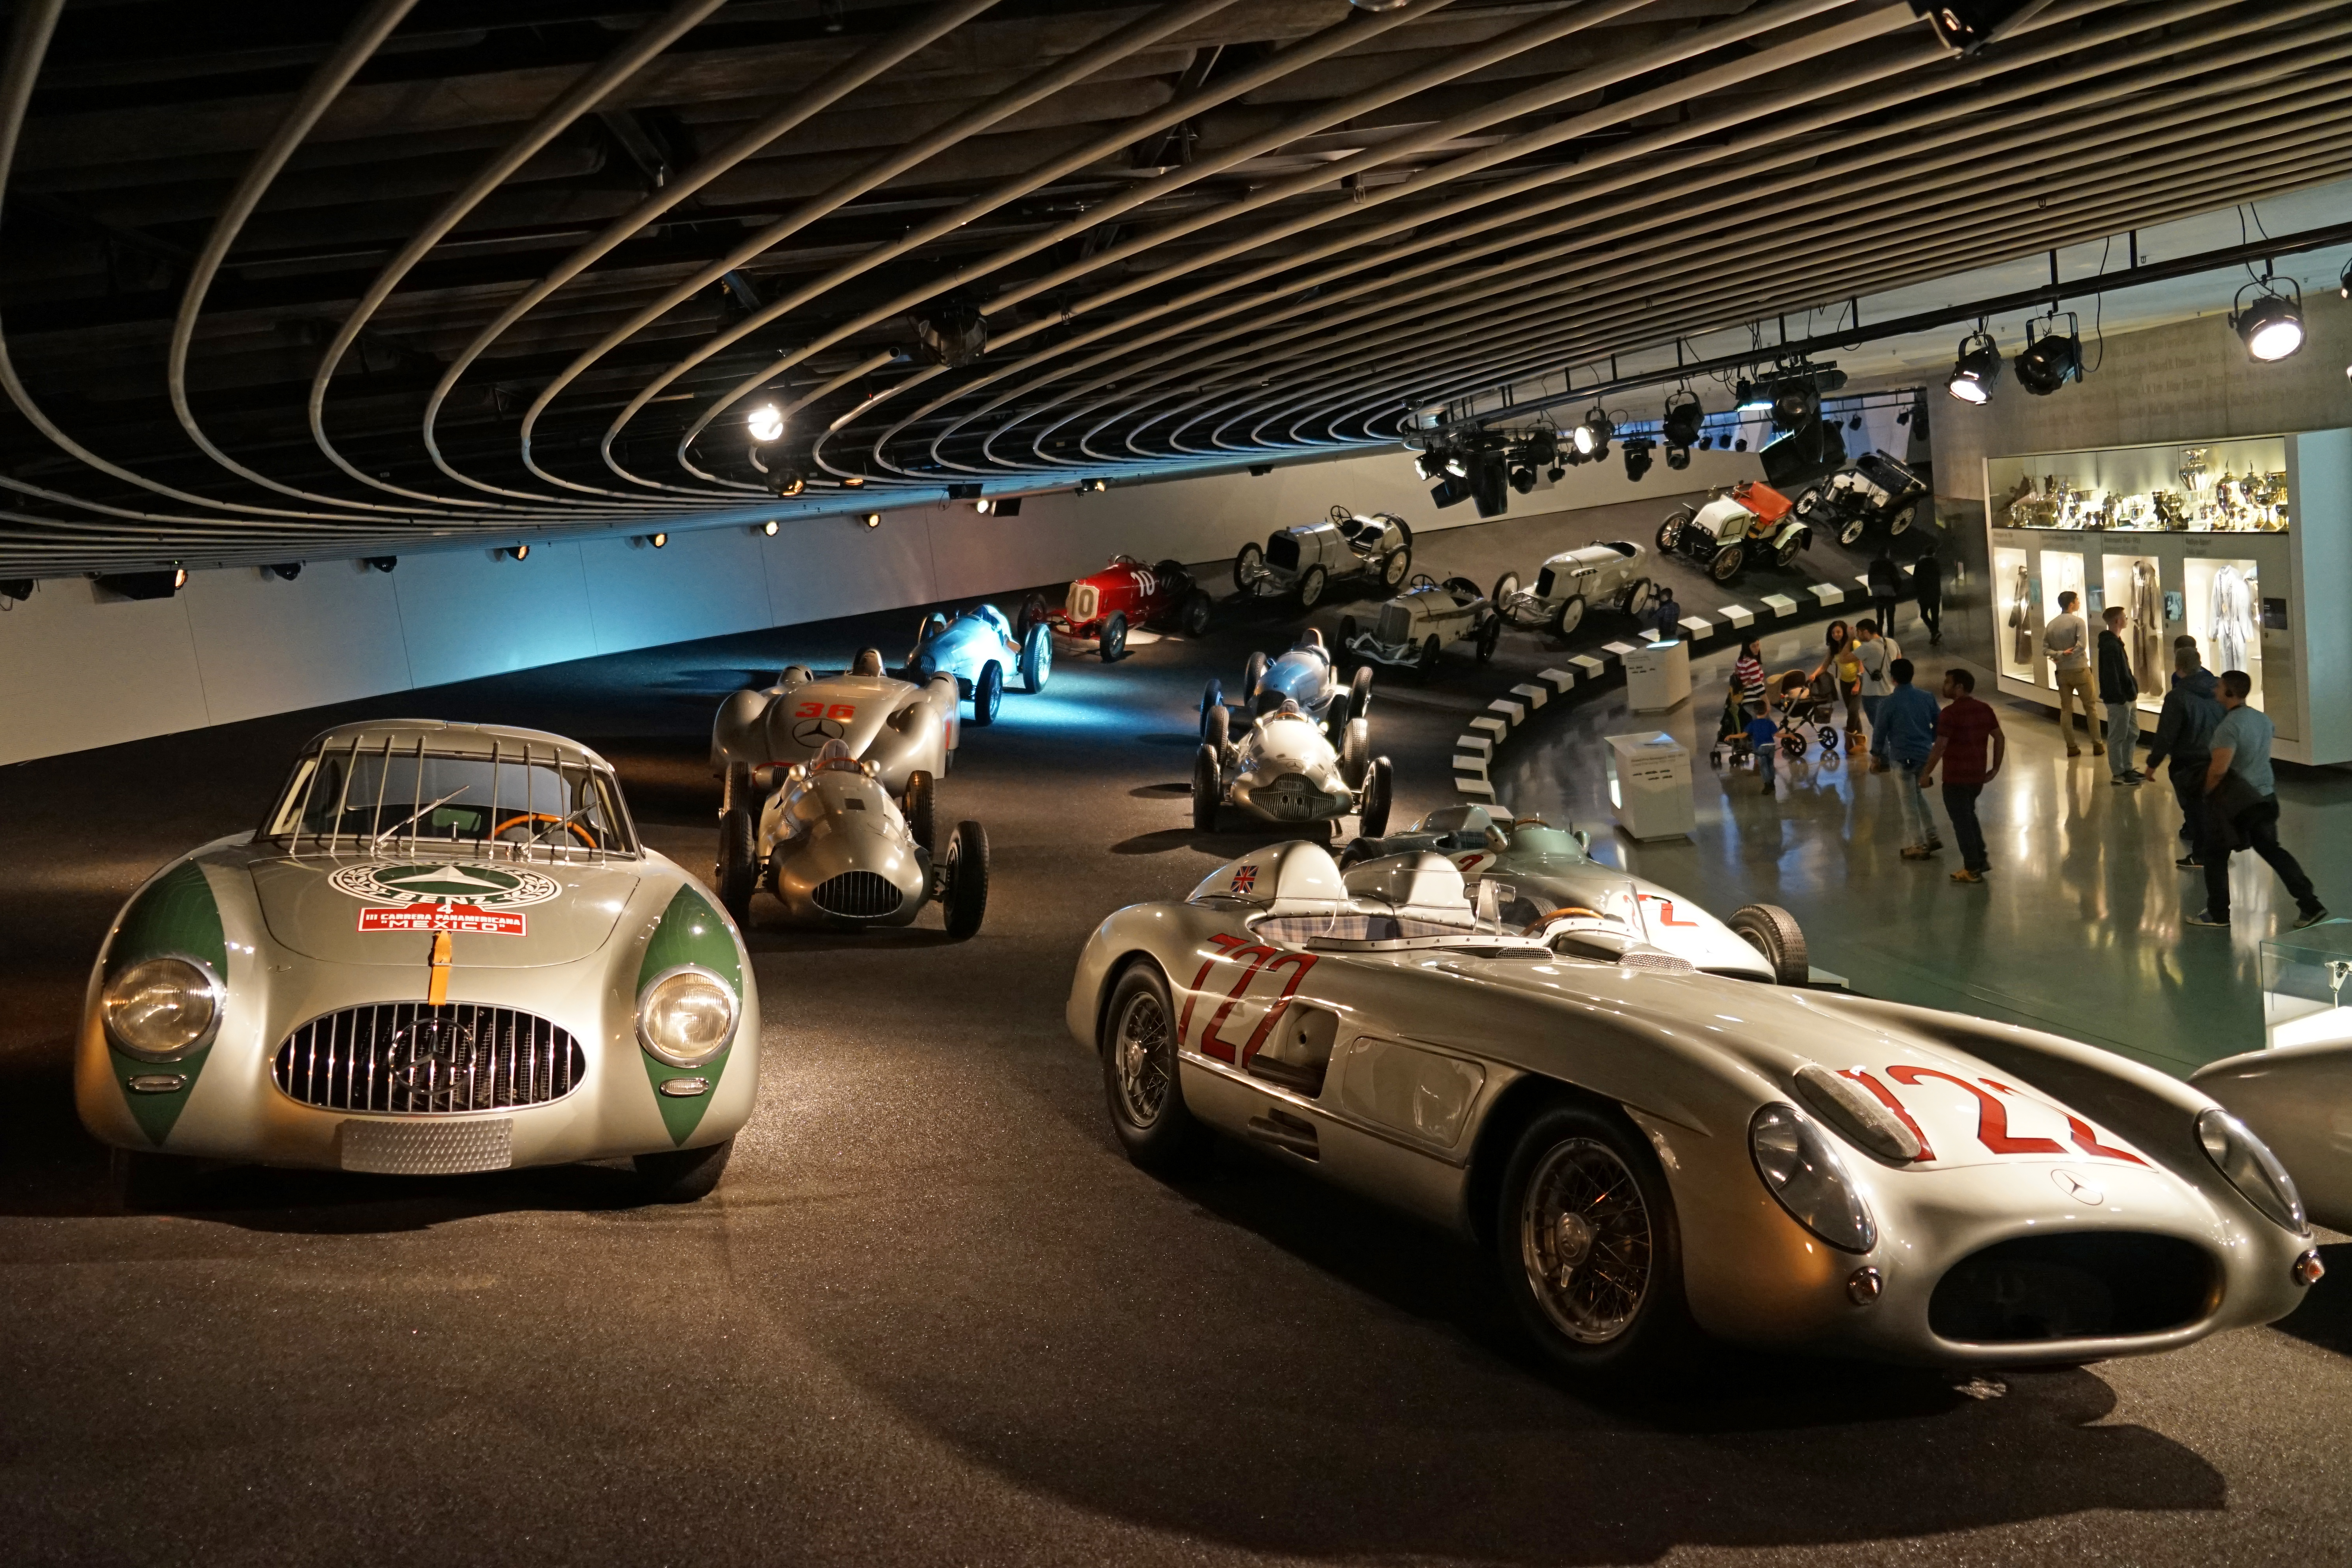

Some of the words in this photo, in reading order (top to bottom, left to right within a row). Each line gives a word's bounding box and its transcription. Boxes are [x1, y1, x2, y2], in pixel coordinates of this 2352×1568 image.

[1131, 570, 1155, 597] 10
[1070, 587, 1094, 618] 10
[795, 702, 856, 719] 36
[392, 892, 492, 904] BENZ
[437, 904, 454, 914] 4
[436, 914, 521, 925] PANAMERICANA
